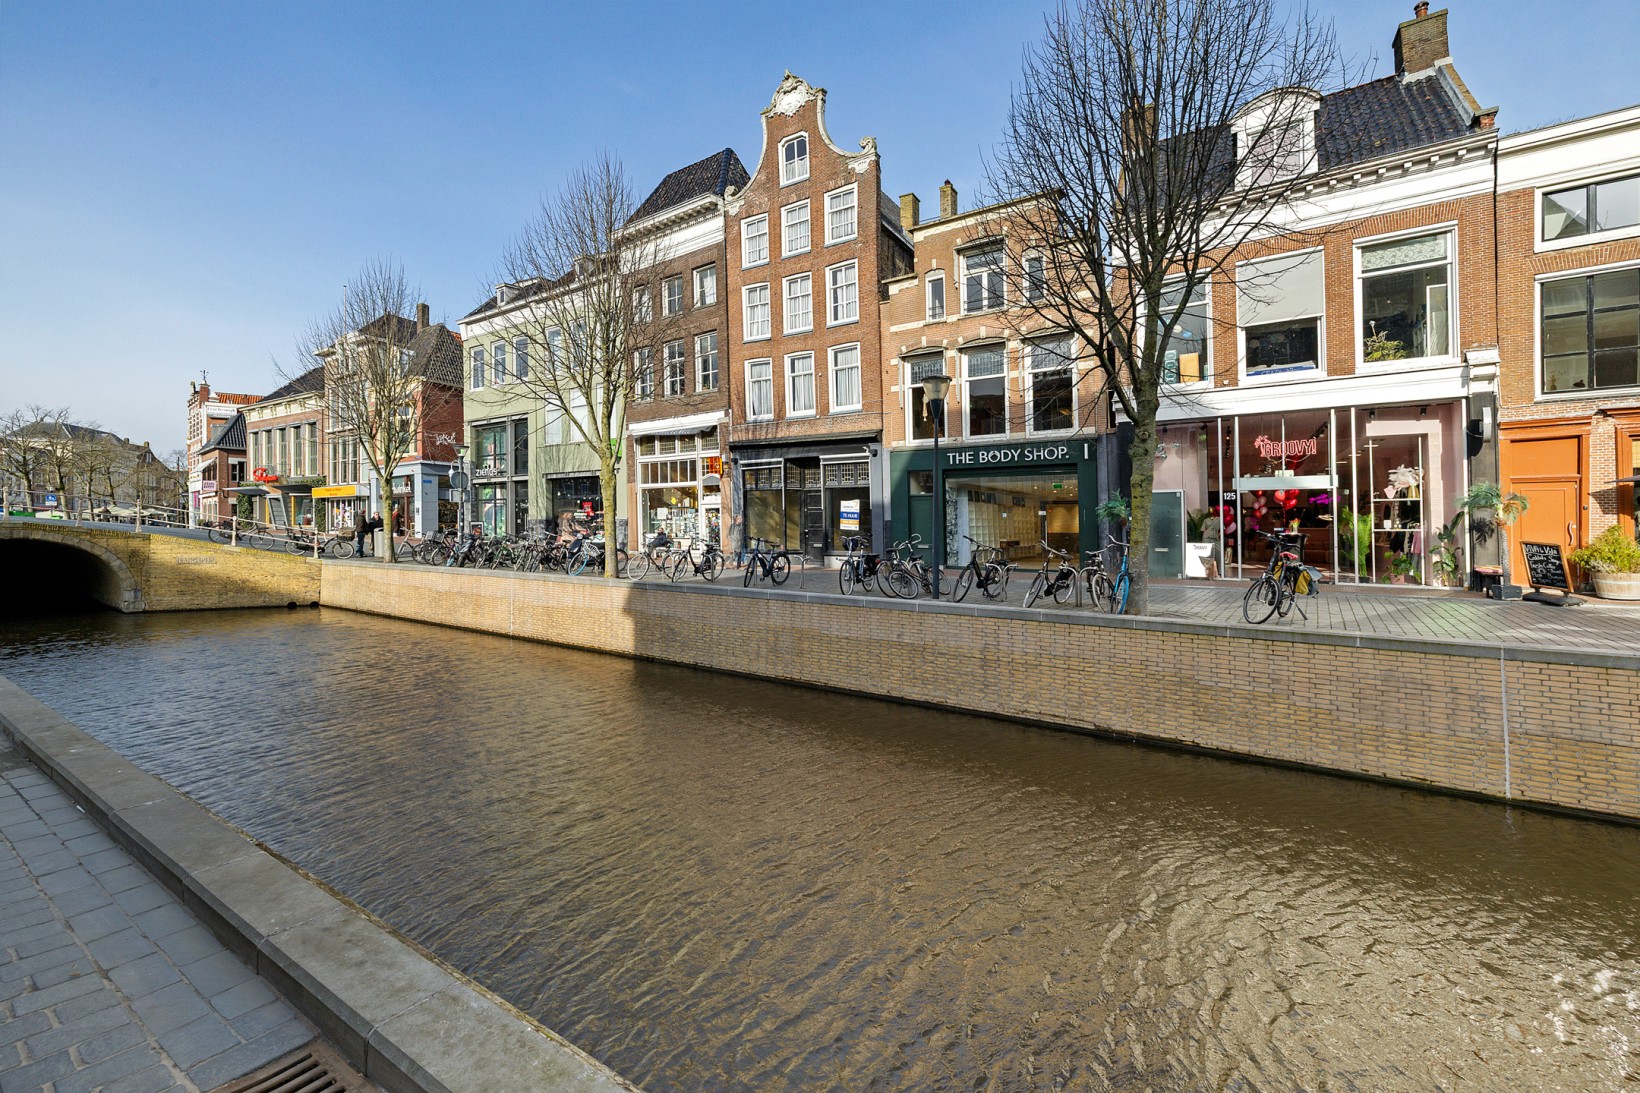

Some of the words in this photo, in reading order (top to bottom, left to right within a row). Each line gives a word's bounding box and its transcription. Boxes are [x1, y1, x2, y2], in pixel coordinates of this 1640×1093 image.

[1264, 438, 1317, 457] GROOVY!
[947, 452, 975, 465] THE
[979, 449, 1021, 464] BODY
[1223, 492, 1236, 501] 125
